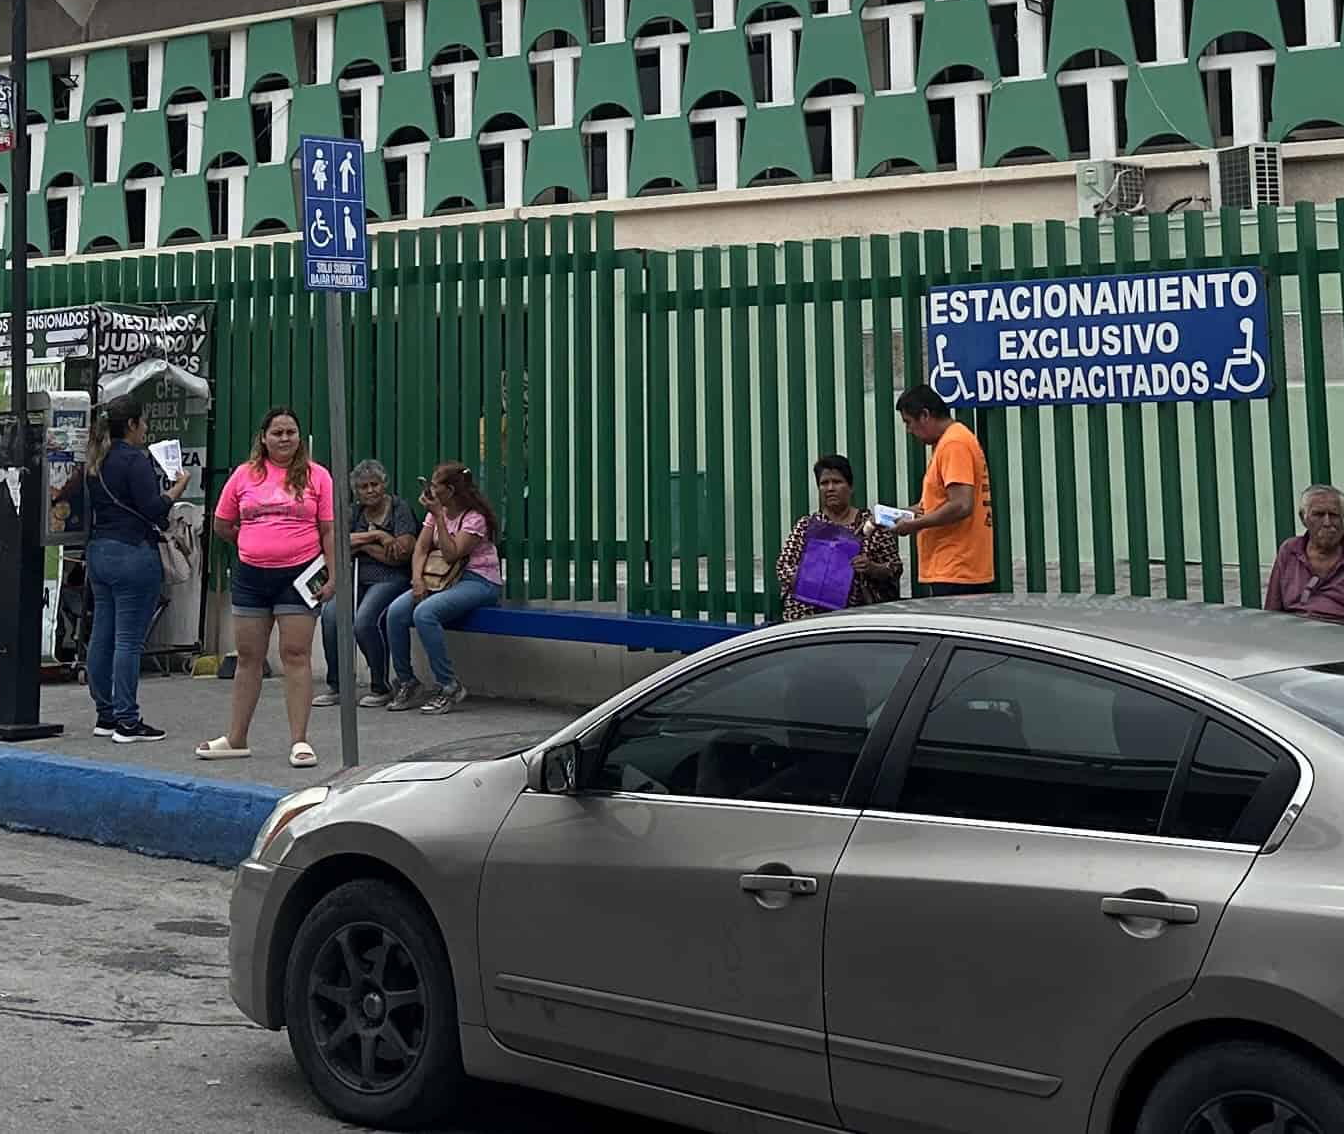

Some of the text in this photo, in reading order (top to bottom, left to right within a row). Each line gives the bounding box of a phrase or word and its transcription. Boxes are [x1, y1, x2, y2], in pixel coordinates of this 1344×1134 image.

[930, 270, 1257, 325] ESTACIONAMIENTO
[26, 311, 90, 331] ENSIONADOS
[999, 322, 1180, 361] EXCLUSIVO
[976, 360, 1209, 402] DISCAPACITADOS
